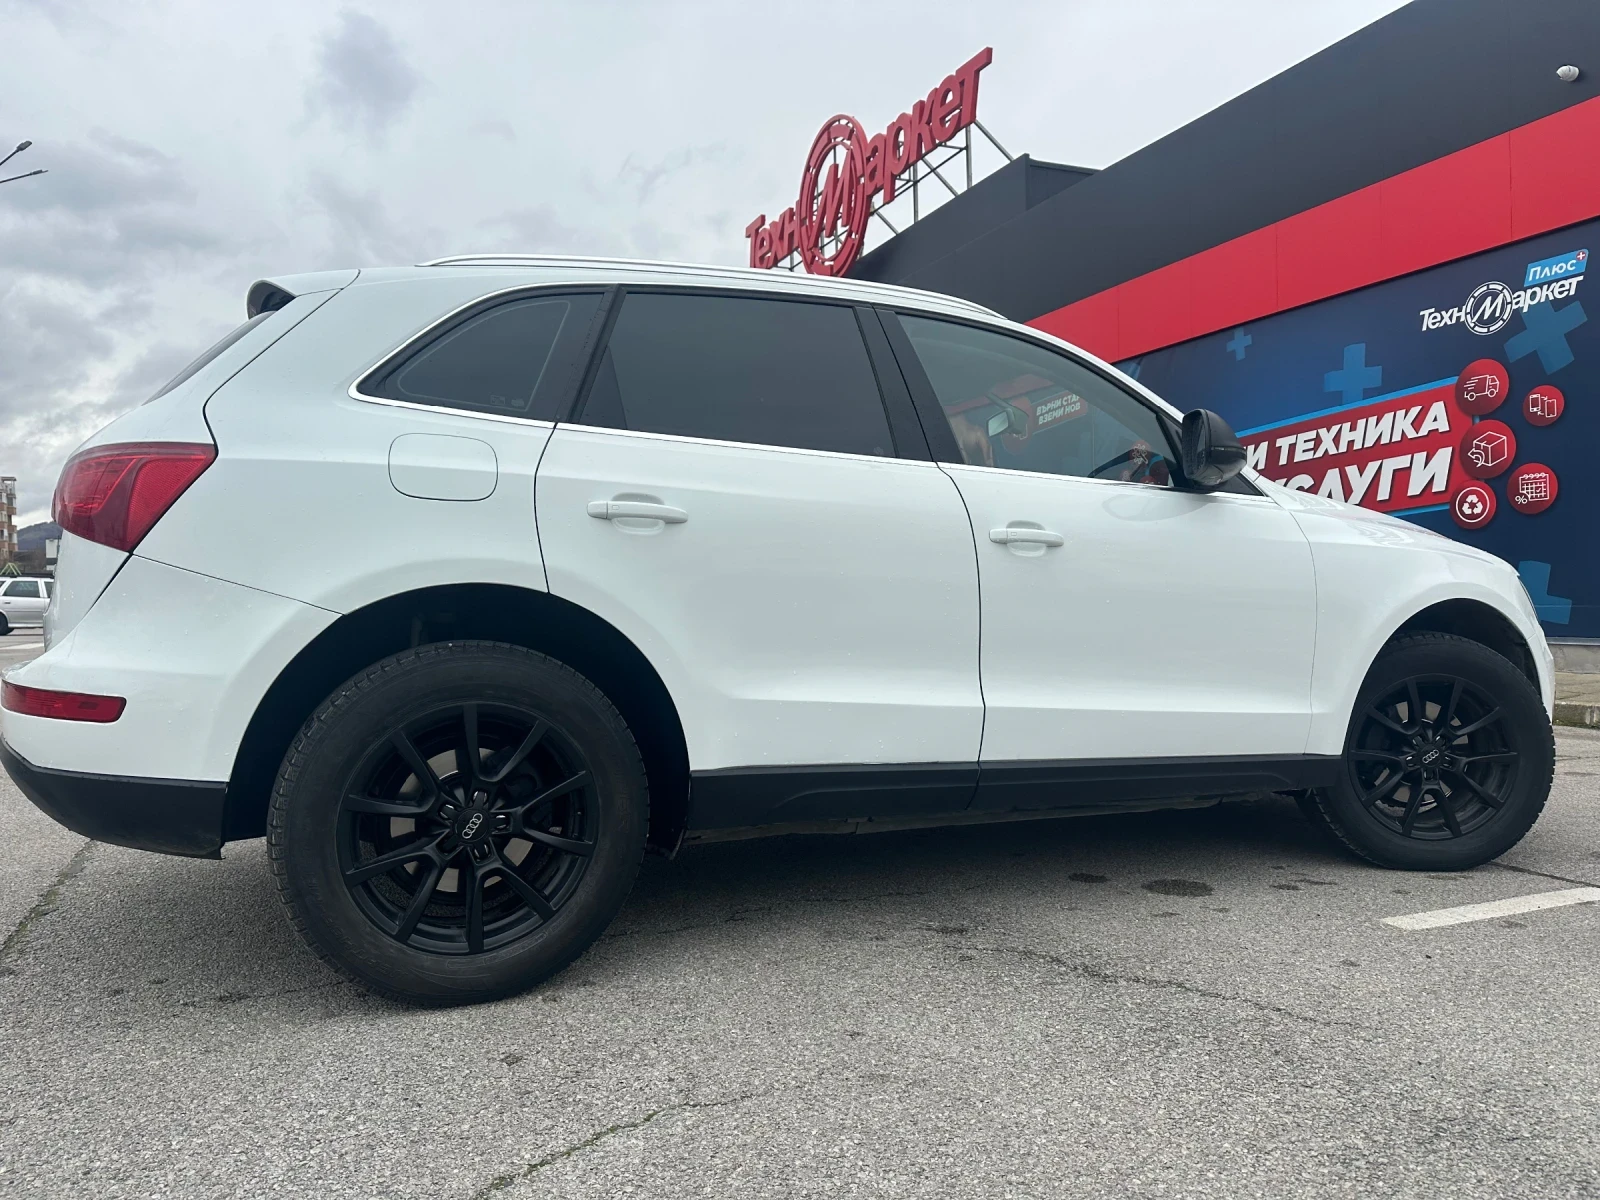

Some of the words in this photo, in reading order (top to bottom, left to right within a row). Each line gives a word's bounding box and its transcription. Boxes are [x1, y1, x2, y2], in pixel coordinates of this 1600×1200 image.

[1036, 398, 1061, 416] ВЪРНИ
[1038, 406, 1064, 425] ВЗЕМИ
[1064, 402, 1081, 415] НОВ
[1275, 400, 1451, 466] ТЕХНИКА
[1274, 446, 1453, 505] ЛУГИ
